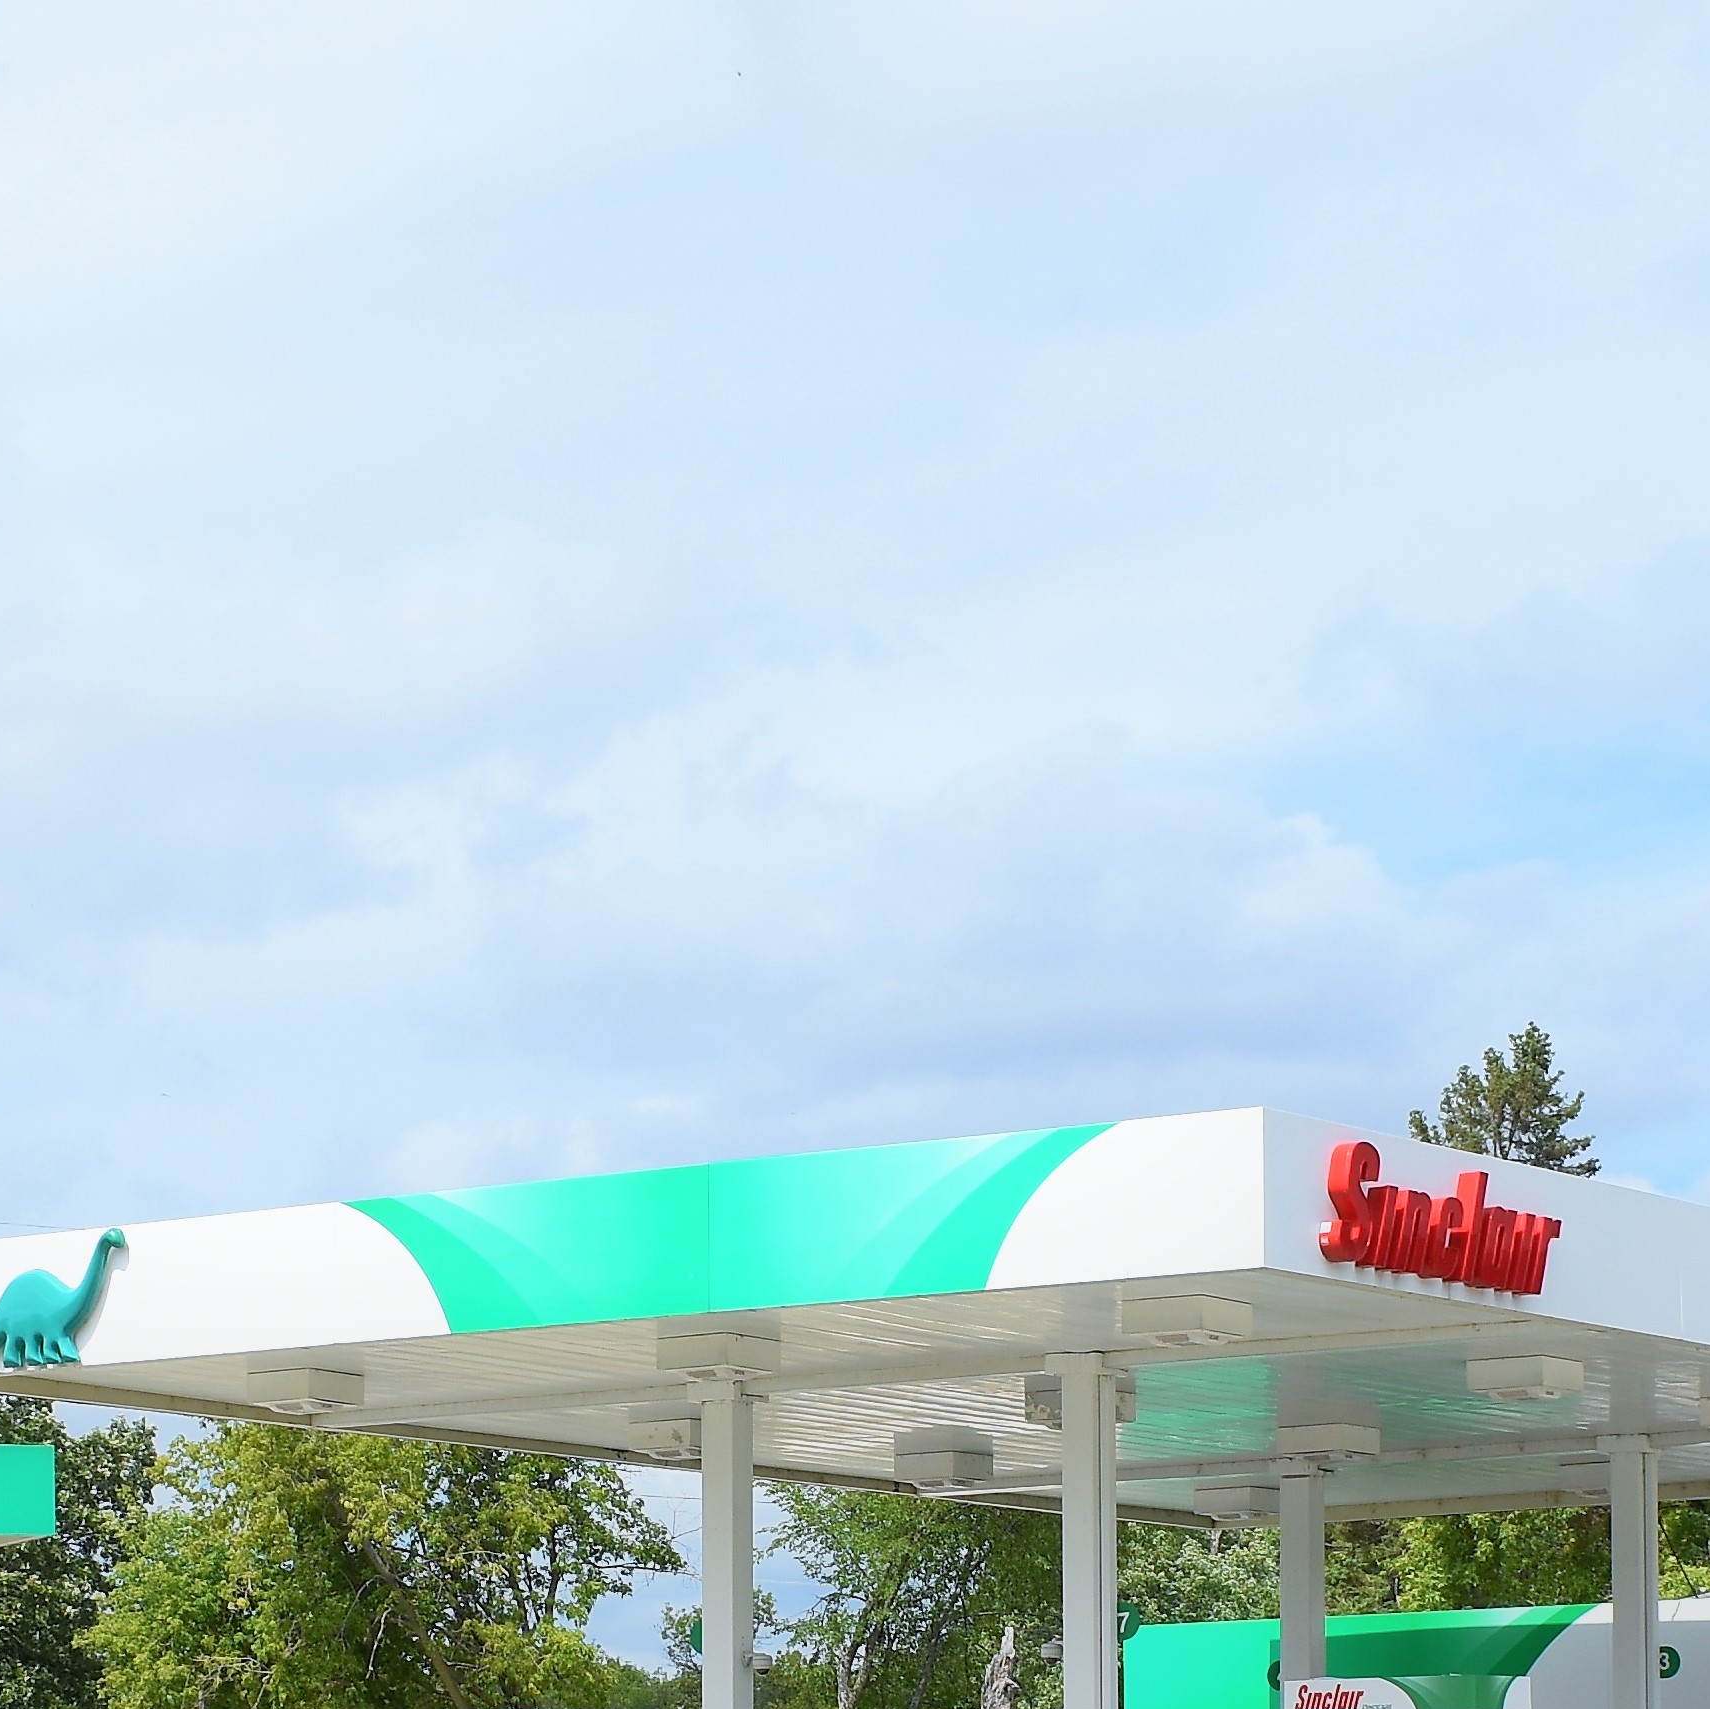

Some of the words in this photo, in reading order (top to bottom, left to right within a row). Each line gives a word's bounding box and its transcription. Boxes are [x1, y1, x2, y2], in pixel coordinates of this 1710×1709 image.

[1319, 1141, 1562, 1296] Sinclair
[1117, 1611, 1130, 1633] 7
[1659, 1652, 1670, 1671] 3
